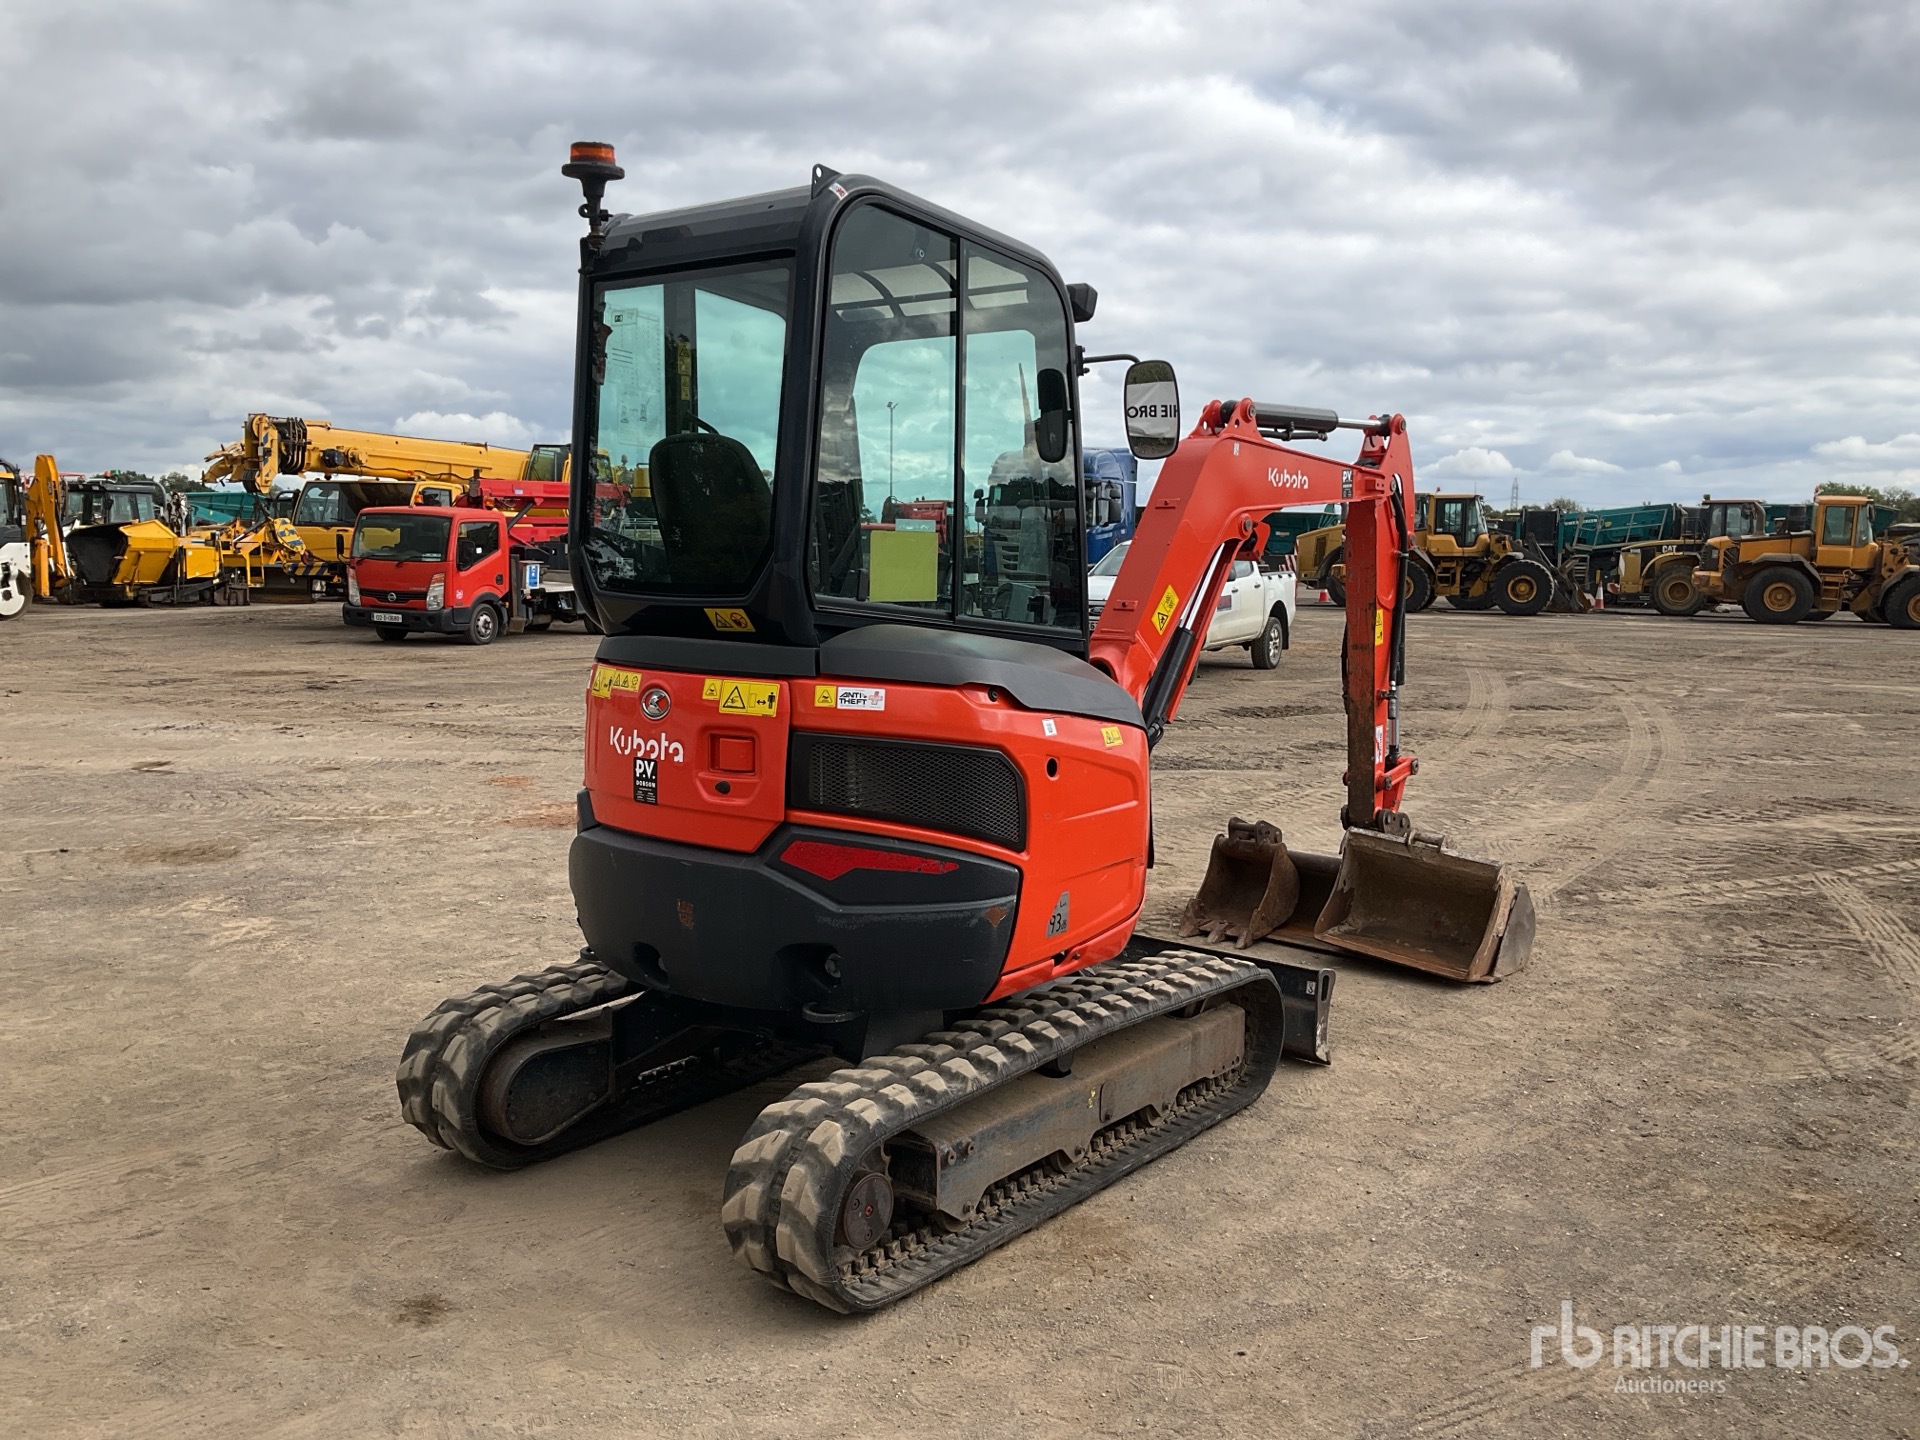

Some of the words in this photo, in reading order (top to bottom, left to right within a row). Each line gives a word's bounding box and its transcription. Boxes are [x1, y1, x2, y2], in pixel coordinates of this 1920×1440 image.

[1268, 467, 1309, 490] Kubota
[1662, 545, 1678, 554] CAT
[609, 725, 684, 763] Kubota
